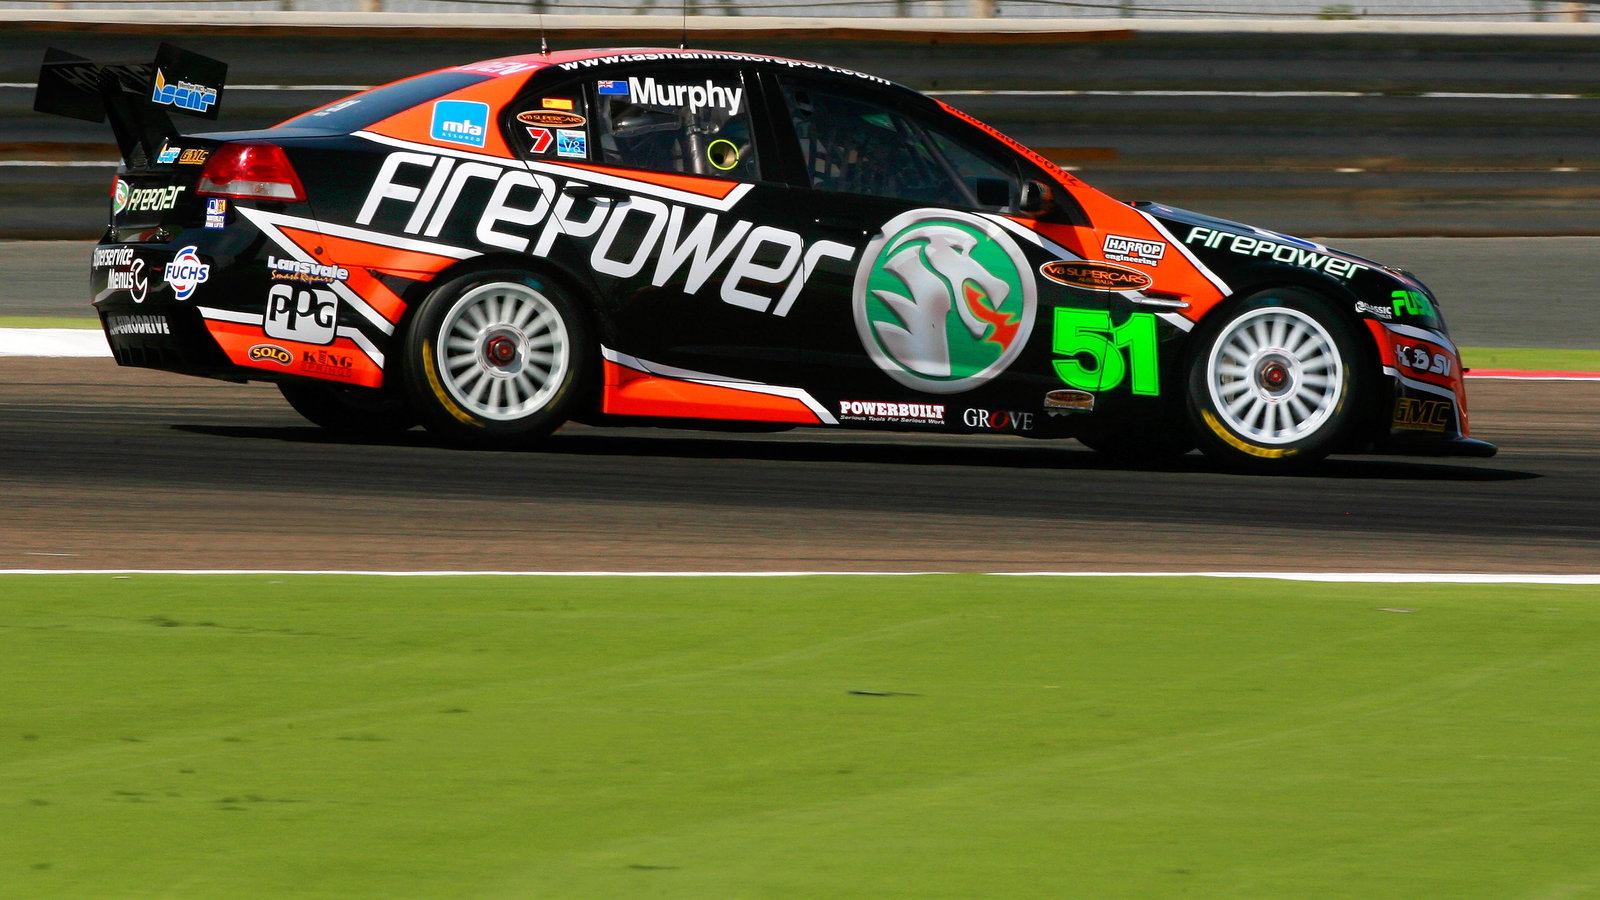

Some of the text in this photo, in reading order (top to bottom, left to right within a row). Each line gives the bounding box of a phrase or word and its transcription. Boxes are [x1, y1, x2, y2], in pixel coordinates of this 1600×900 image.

[628, 76, 742, 115] Murphy
[442, 119, 482, 136] mta
[442, 132, 481, 142] ASSURED
[1109, 239, 1161, 255] HARROP
[267, 256, 349, 281] Lansvale
[1105, 253, 1157, 266] engineering
[107, 268, 134, 289] Menus
[165, 263, 207, 281] FUCHS
[271, 270, 334, 284] Smash Repairs
[1048, 265, 1147, 284] V8 SUPERCARS
[268, 289, 335, 332] PPG
[253, 347, 289, 362] SOLO
[303, 350, 353, 368] KING
[1052, 307, 1159, 396] 51
[839, 401, 945, 419] POWERBUILT
[963, 408, 1033, 430] GROVE
[1394, 398, 1452, 426] GMC
